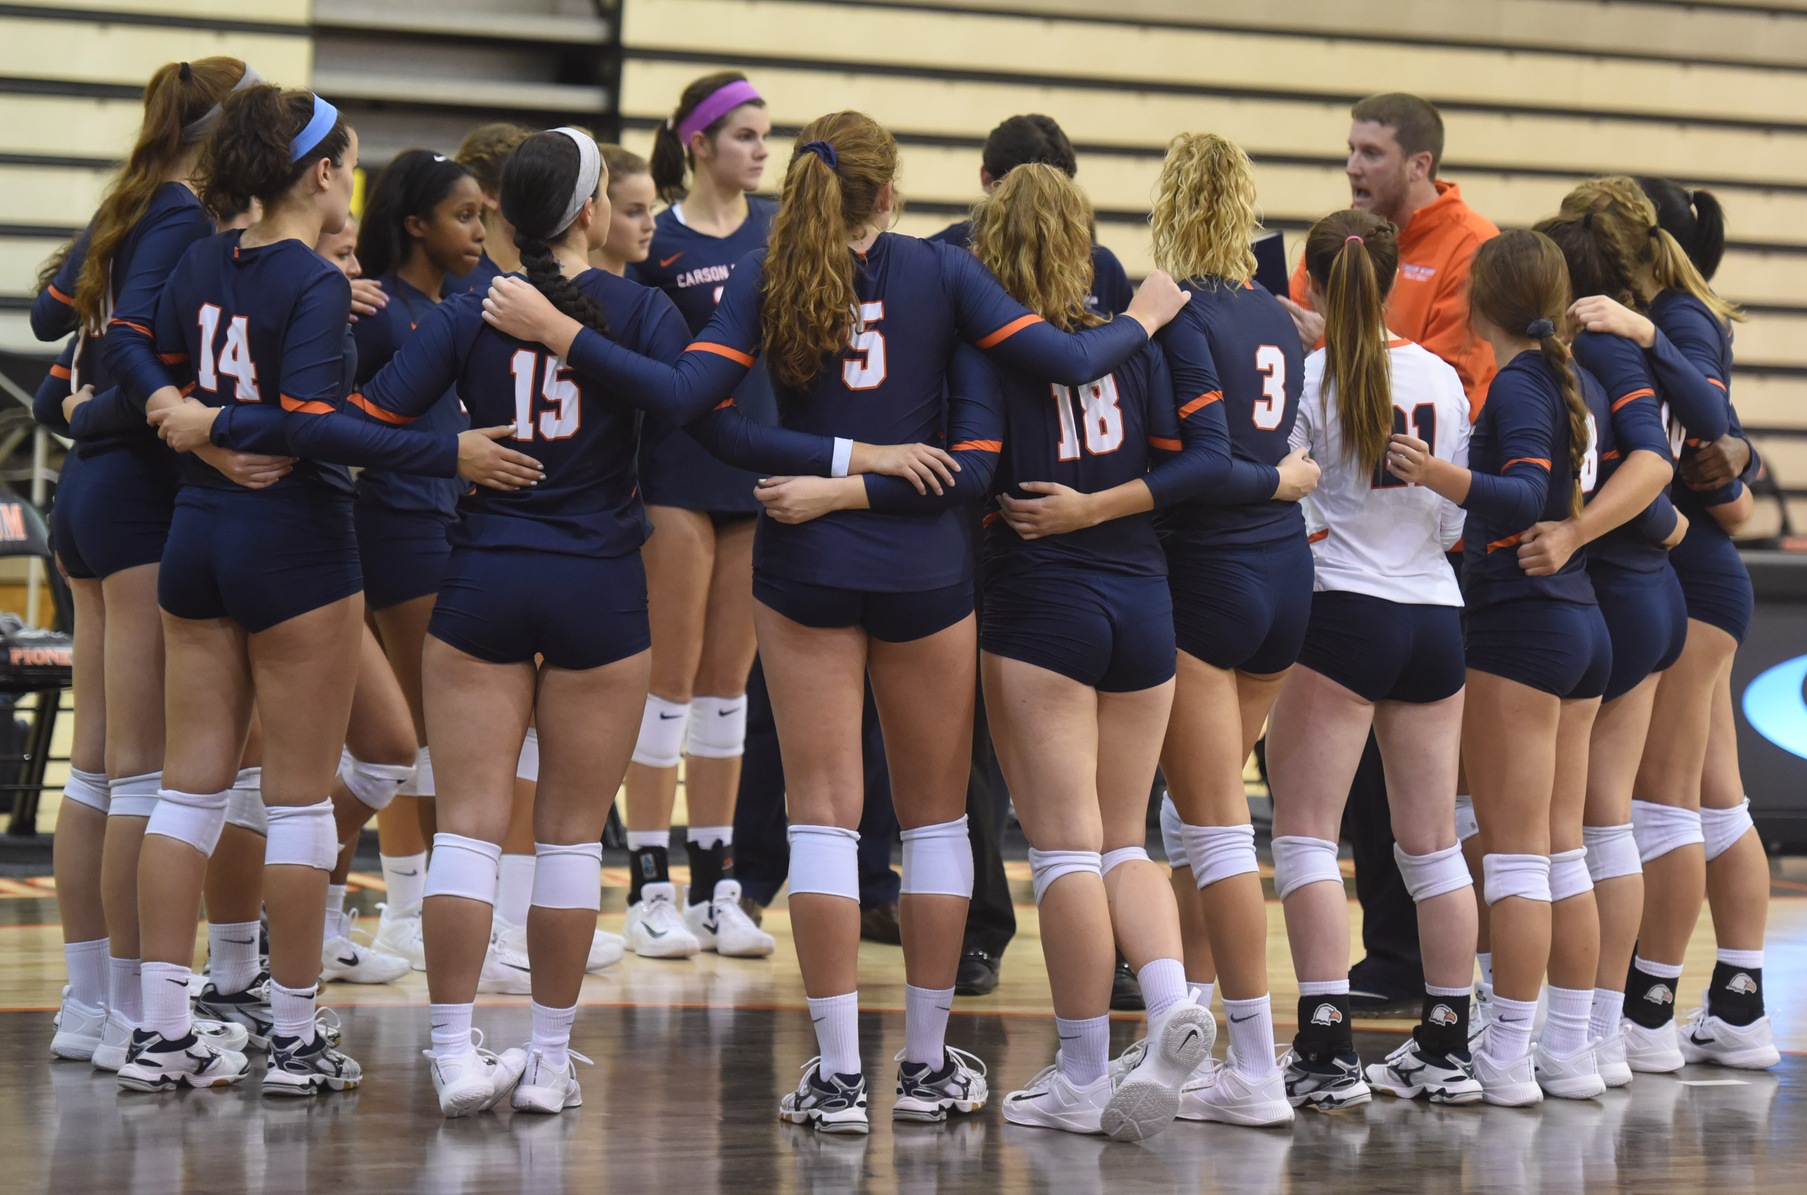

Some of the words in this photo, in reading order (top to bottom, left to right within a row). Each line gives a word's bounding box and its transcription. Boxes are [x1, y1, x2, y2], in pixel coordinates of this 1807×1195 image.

[676, 264, 730, 289] CARSON
[197, 301, 262, 403] 14
[841, 299, 887, 391] 5
[1252, 344, 1286, 431] 3
[509, 347, 582, 442] 15
[1049, 371, 1125, 462] 18
